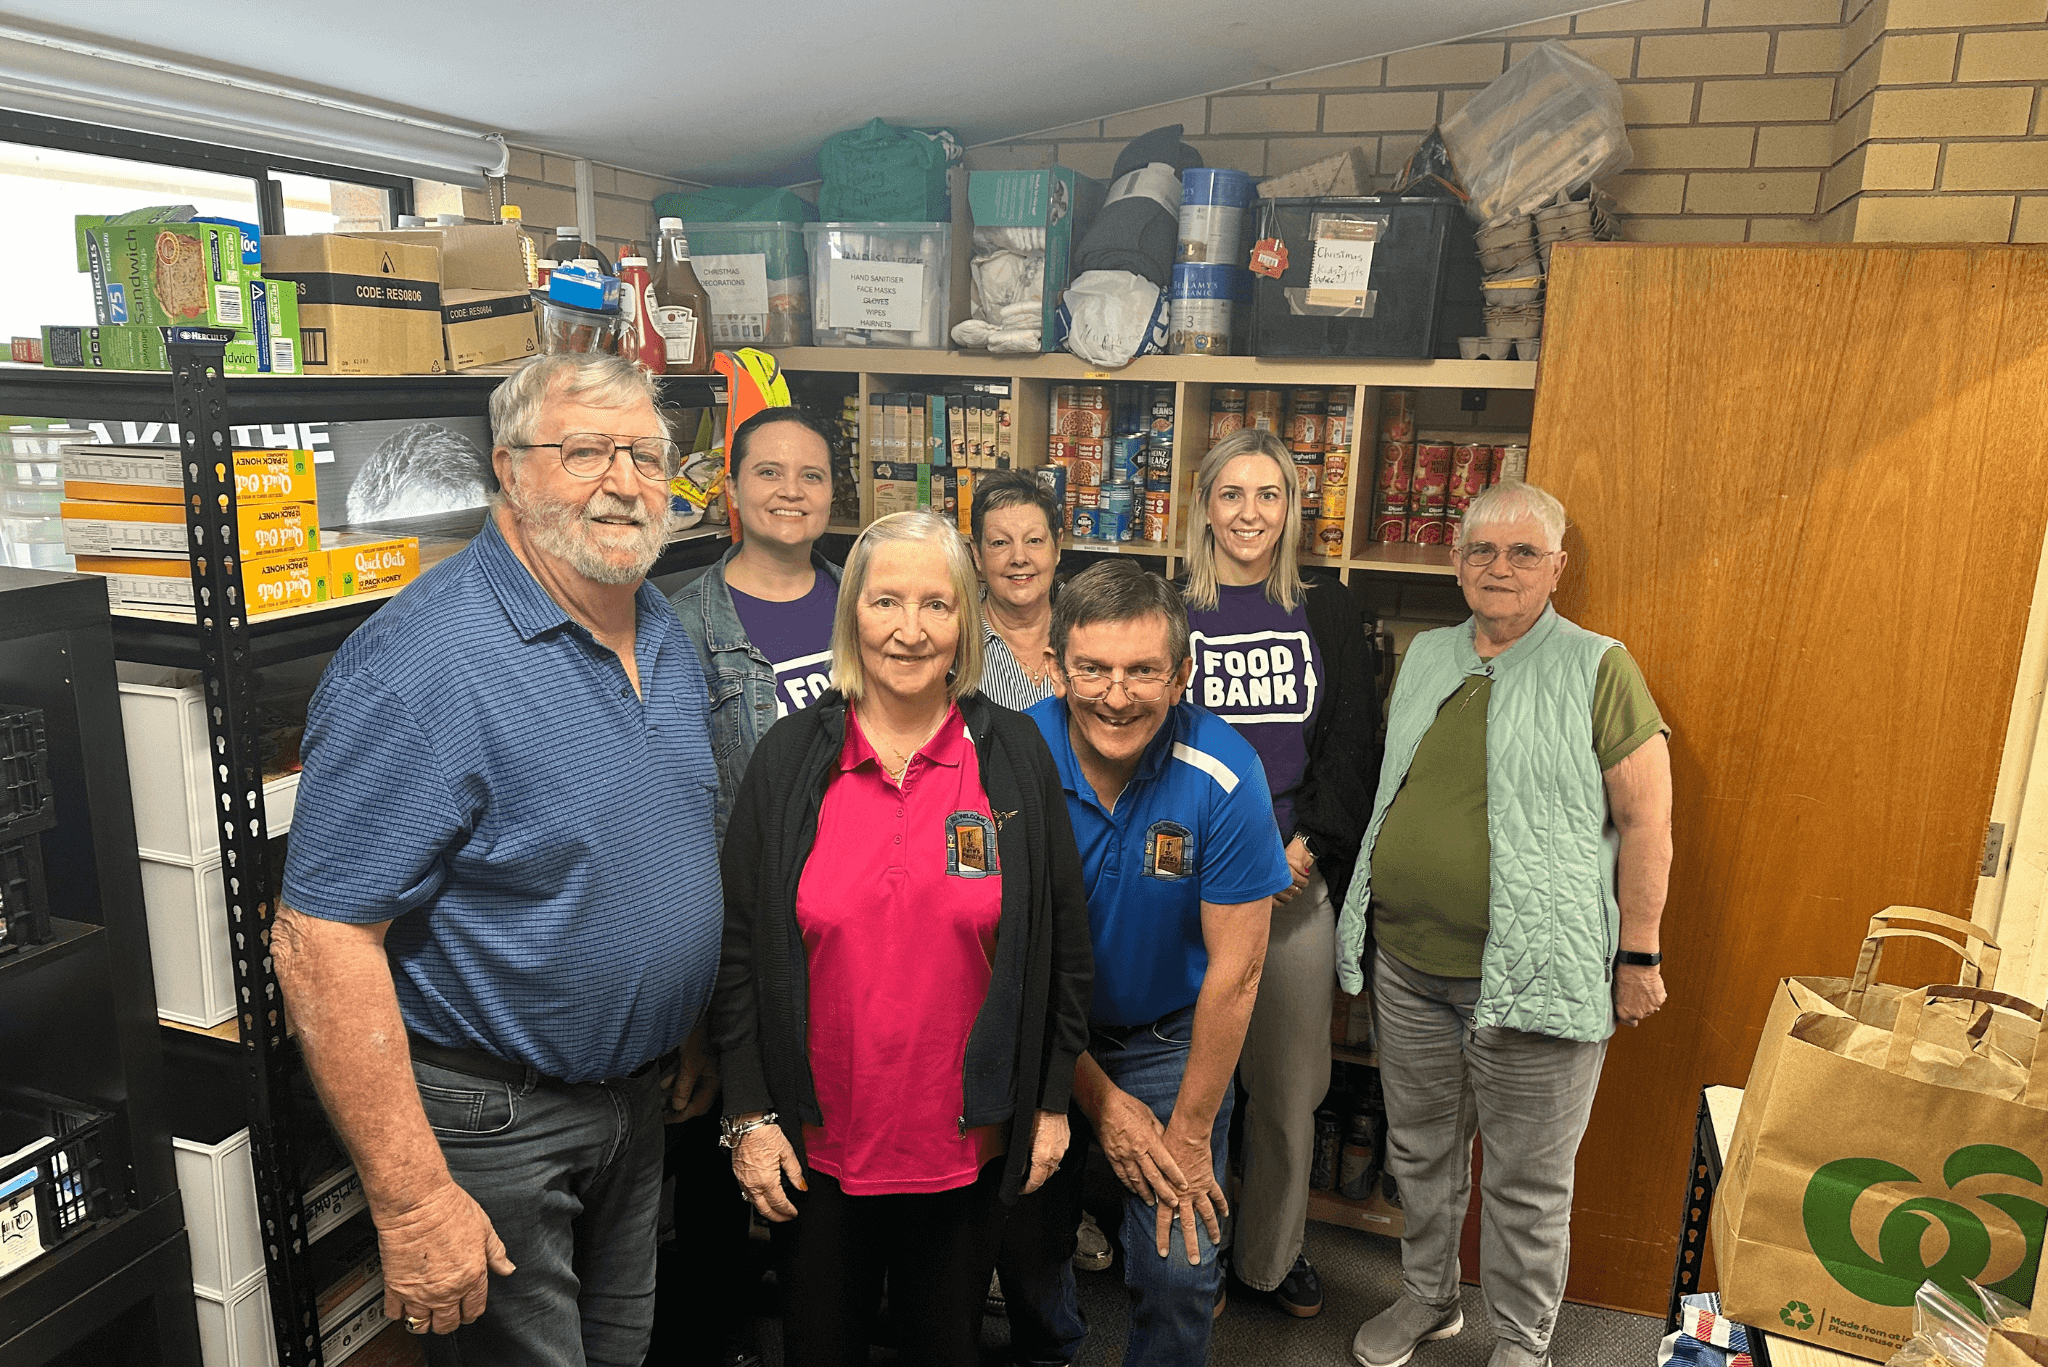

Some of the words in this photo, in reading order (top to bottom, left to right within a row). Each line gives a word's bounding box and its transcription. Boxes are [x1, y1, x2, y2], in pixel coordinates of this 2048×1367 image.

[1317, 246, 1363, 262] Christmas
[90, 243, 104, 305] HERCULES
[125, 229, 146, 325] Sandwich
[703, 268, 740, 276] CHRISTMAS
[700, 279, 746, 287] DECORATIONS
[851, 274, 871, 283] HAND
[871, 275, 904, 284] SANITISER
[356, 285, 385, 300] CODE:
[386, 288, 422, 302] RES0806
[856, 286, 873, 294] FACE
[874, 287, 897, 295] MASKS
[110, 291, 125, 316] 75
[862, 297, 889, 305] GLOVES
[450, 308, 468, 319] CODE:
[865, 309, 887, 317] WIPES
[860, 320, 892, 328] HAIRNETS
[1186, 316, 1194, 328] 3
[191, 330, 228, 342] HERCULES
[225, 351, 256, 364] ndwich
[1152, 407, 1174, 415] BEANS
[236, 458, 261, 466] HONEY
[235, 473, 260, 495] Oat
[262, 473, 292, 495] Quick
[258, 512, 279, 521] HONEY
[279, 511, 295, 519] PACK
[255, 527, 279, 548] Oats
[280, 526, 304, 548] Quick
[355, 551, 381, 571] Quick
[382, 549, 406, 568] Oats
[261, 566, 285, 575] HONEY
[286, 563, 302, 572] PACK
[364, 577, 381, 586] PACK
[381, 573, 402, 583] HONEY
[257, 580, 284, 602] Oats
[285, 578, 311, 599] Quick
[1203, 645, 1294, 677] FOOD
[783, 669, 833, 710] FO
[1203, 674, 1298, 707] BANK
[959, 813, 986, 823] WELCOME
[1830, 1316, 1860, 1330] Made
[1861, 1324, 1887, 1338] from
[1888, 1333, 1901, 1341] at
[1828, 1324, 1863, 1340] Please
[1864, 1335, 1894, 1347] reuse
